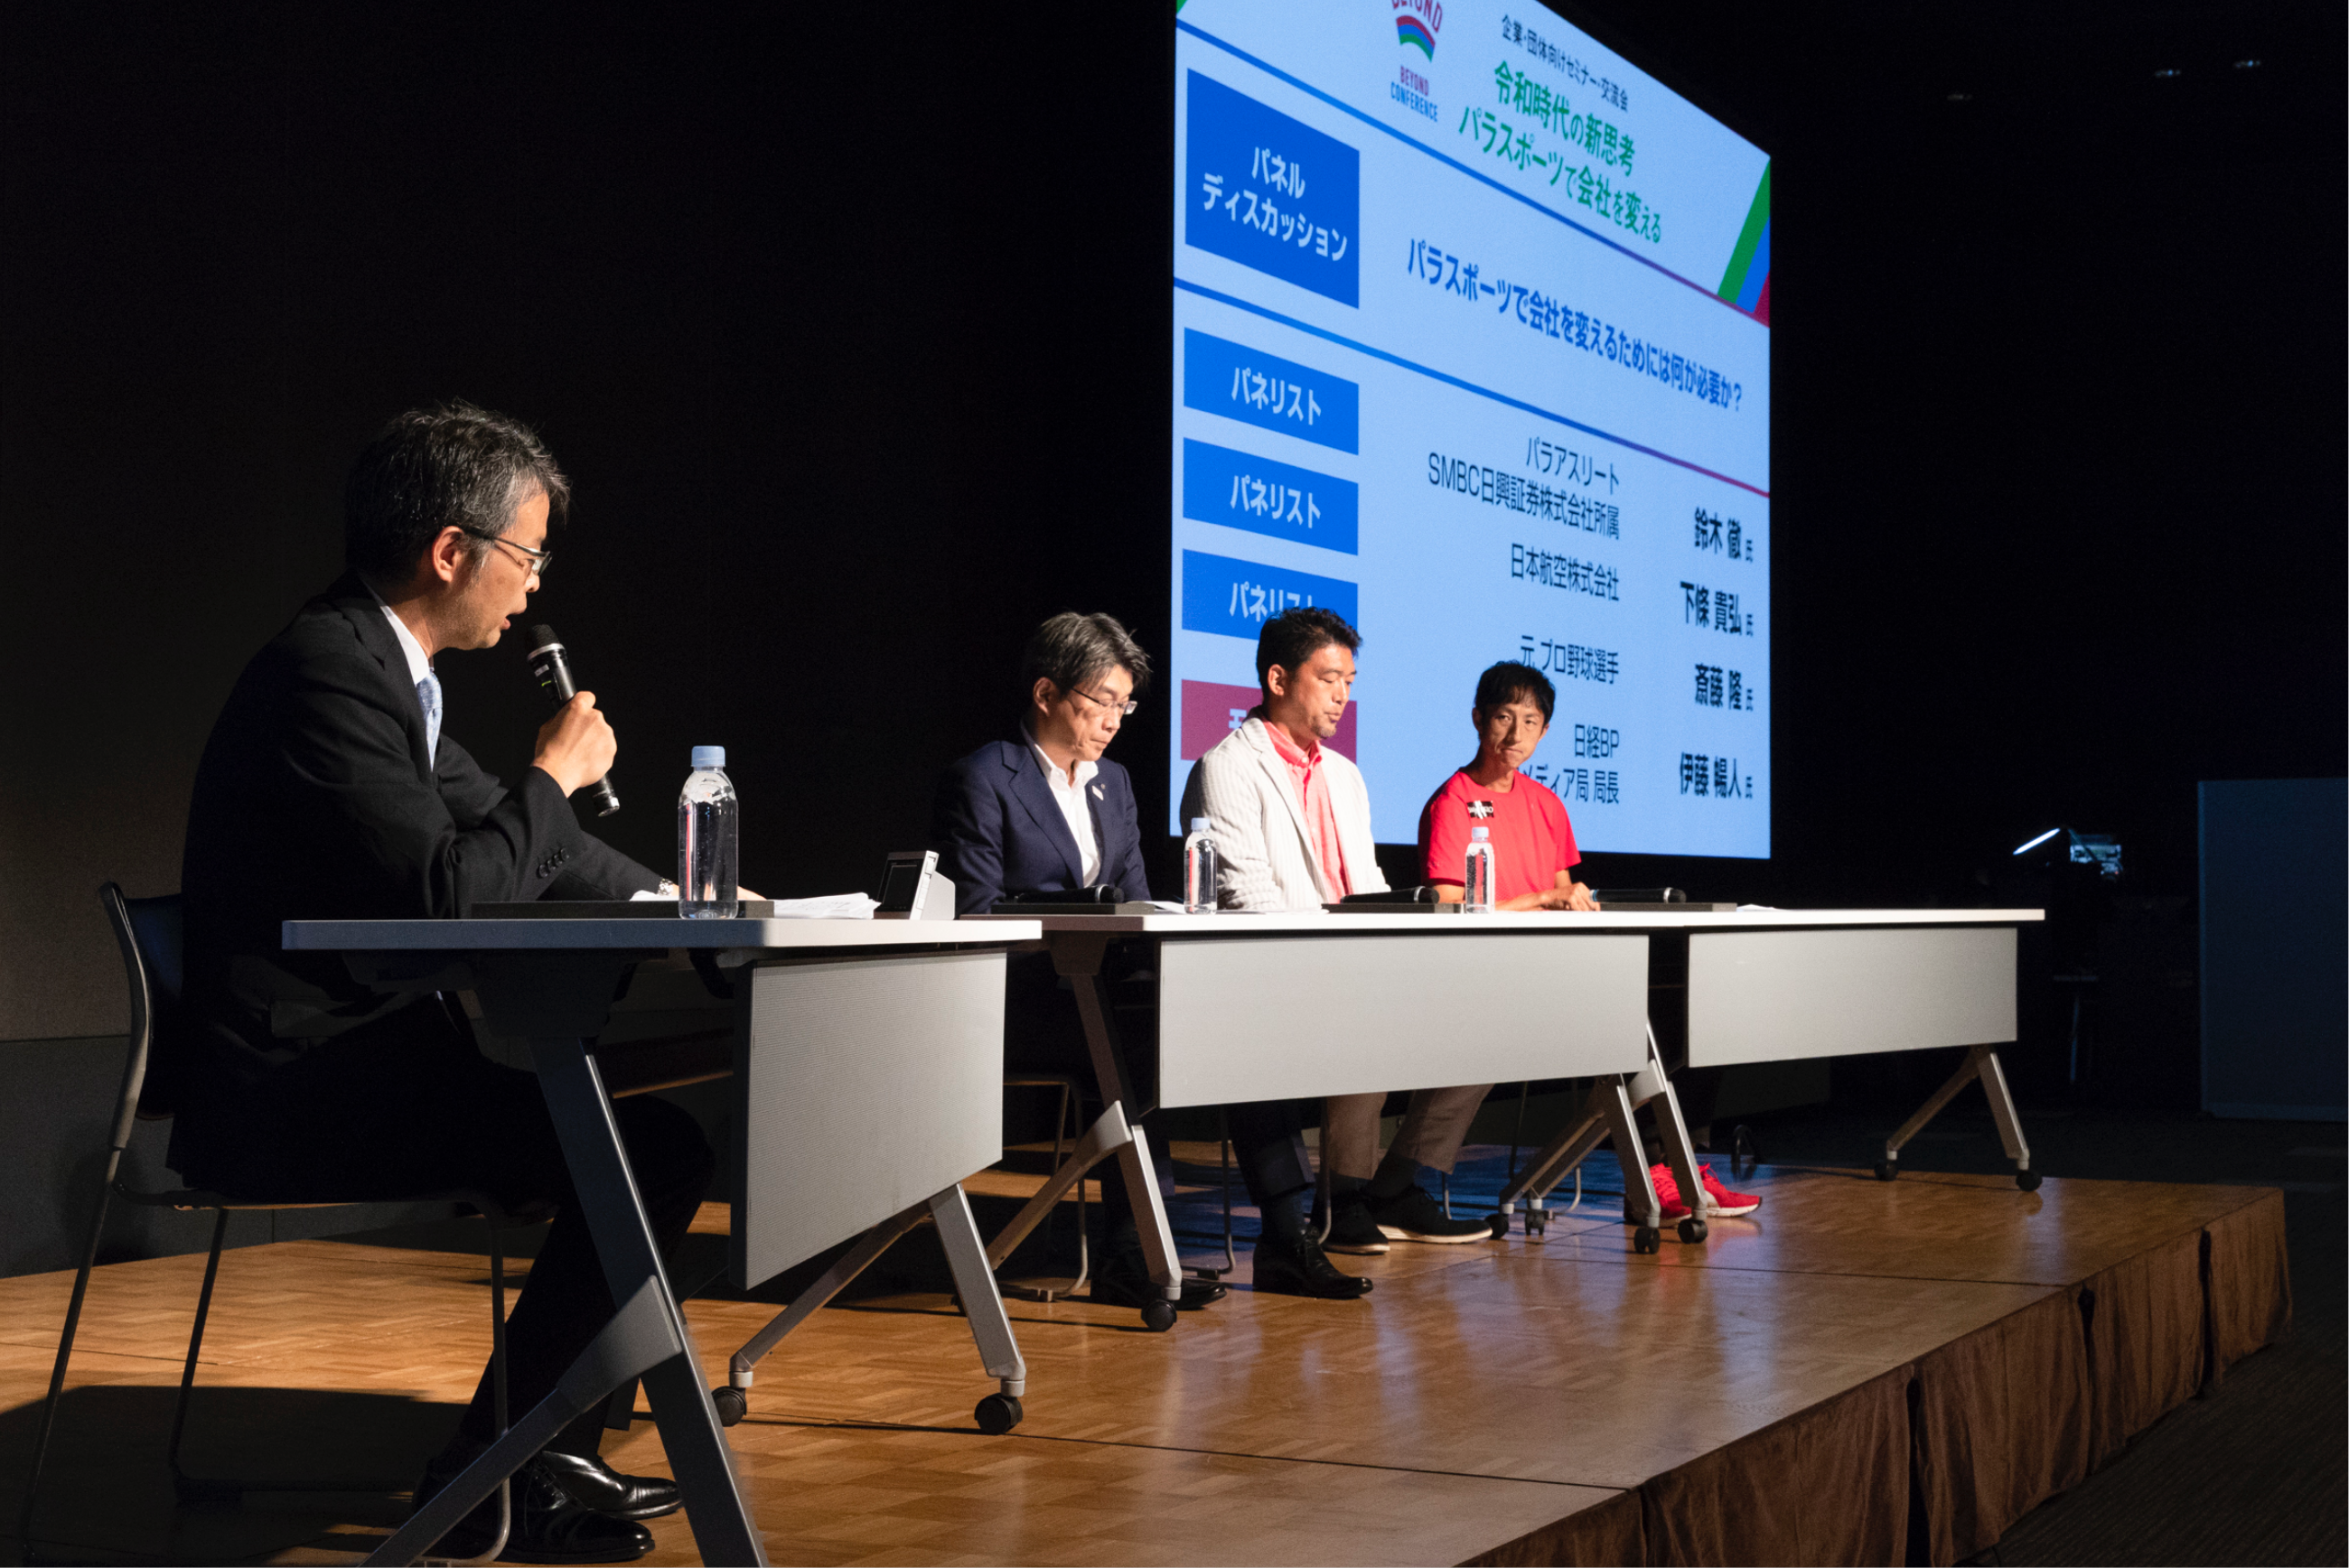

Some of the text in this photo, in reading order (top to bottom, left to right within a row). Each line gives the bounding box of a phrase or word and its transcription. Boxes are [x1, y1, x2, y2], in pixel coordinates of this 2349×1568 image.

[1390, 81, 1438, 122] CONFERENCE
[1400, 66, 1429, 97] BEYOND
[1494, 61, 1635, 177] 令和時代の新思考
[1251, 146, 1306, 199] パネル
[1459, 107, 1661, 243] パラスポーツで会社を変える
[1203, 172, 1348, 262] ディスカッション
[1231, 367, 1322, 425] パネリスト
[1526, 437, 1619, 495] パラアスリート
[1230, 474, 1321, 528] パネリスト
[1428, 452, 1619, 540] SMBC日興証券株式会社所属
[1511, 542, 1619, 602] 日本航空株式会社
[1575, 724, 1620, 759] 日経BP
